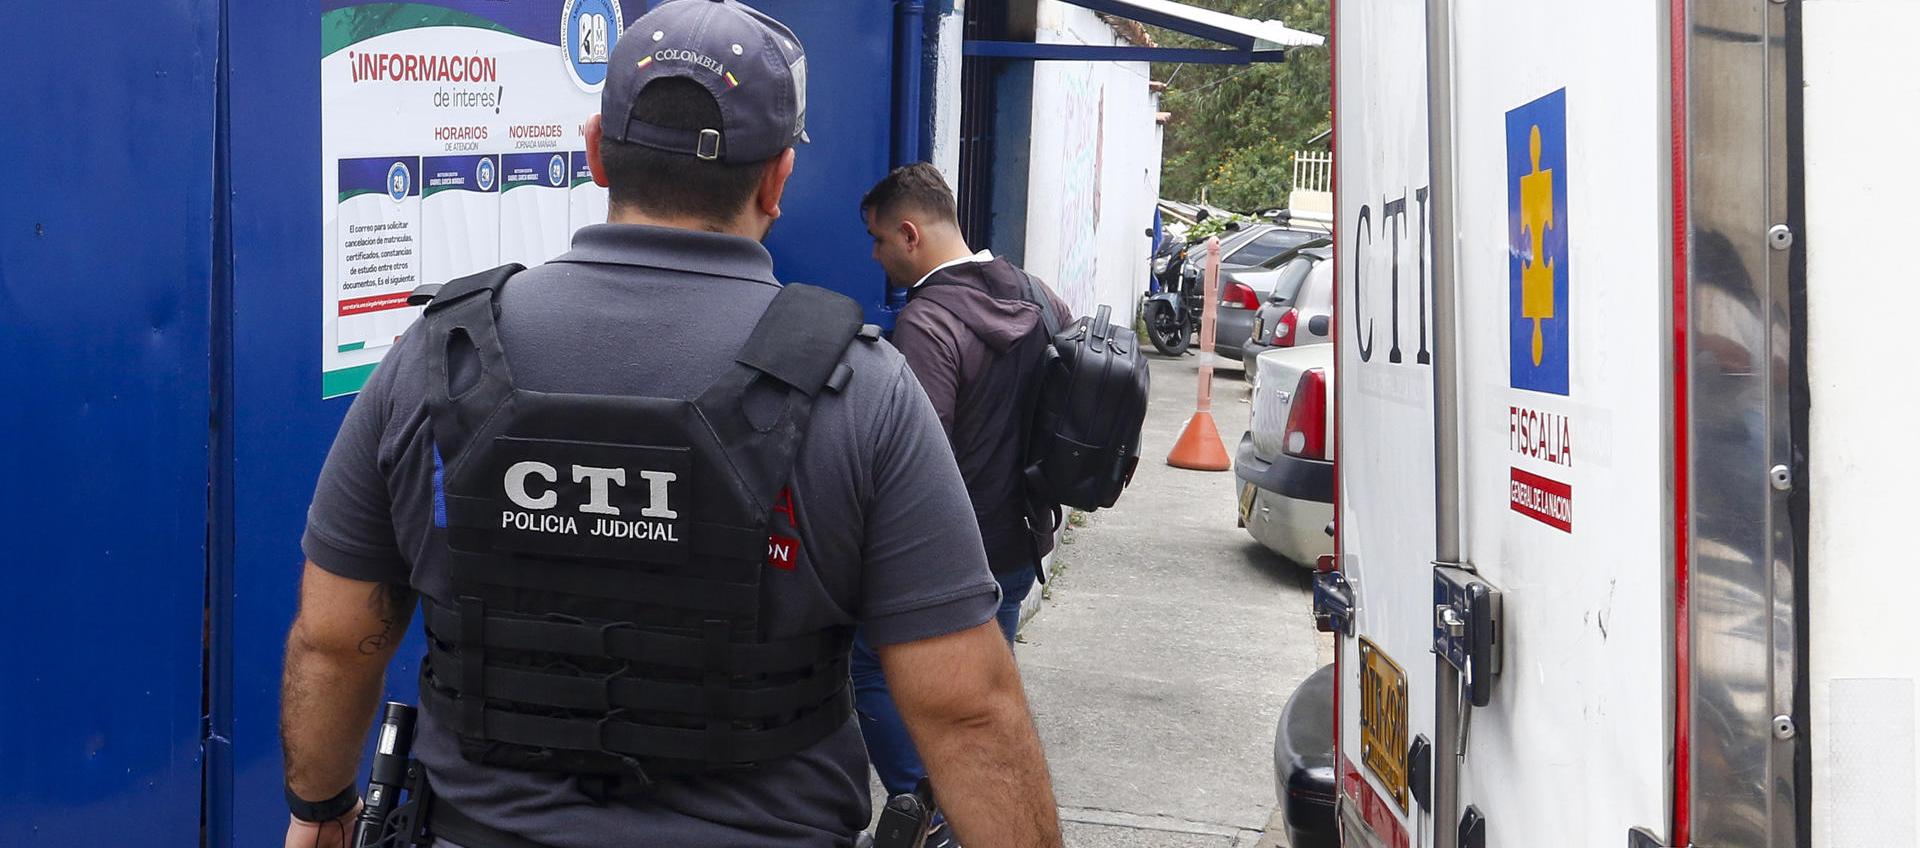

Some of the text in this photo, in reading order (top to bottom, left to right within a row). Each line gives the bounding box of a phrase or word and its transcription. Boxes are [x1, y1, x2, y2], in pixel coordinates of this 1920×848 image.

[349, 49, 496, 83] ¡INFORMACIÓN
[655, 48, 724, 76] COLOMBIA
[433, 85, 503, 114] de interés!
[435, 126, 488, 140] HORARIOS
[509, 125, 562, 139] NOVEDADES
[349, 221, 409, 233] El correo para solicitar
[377, 236, 383, 244] de
[350, 262, 409, 275] de estudio entre otros
[378, 277, 384, 285] Es
[385, 276, 390, 285] el
[1355, 186, 1431, 366] CTI
[1510, 405, 1572, 467] FISCALIA
[503, 460, 679, 520] CTI
[502, 511, 679, 542] POLICIA JUDICIAL
